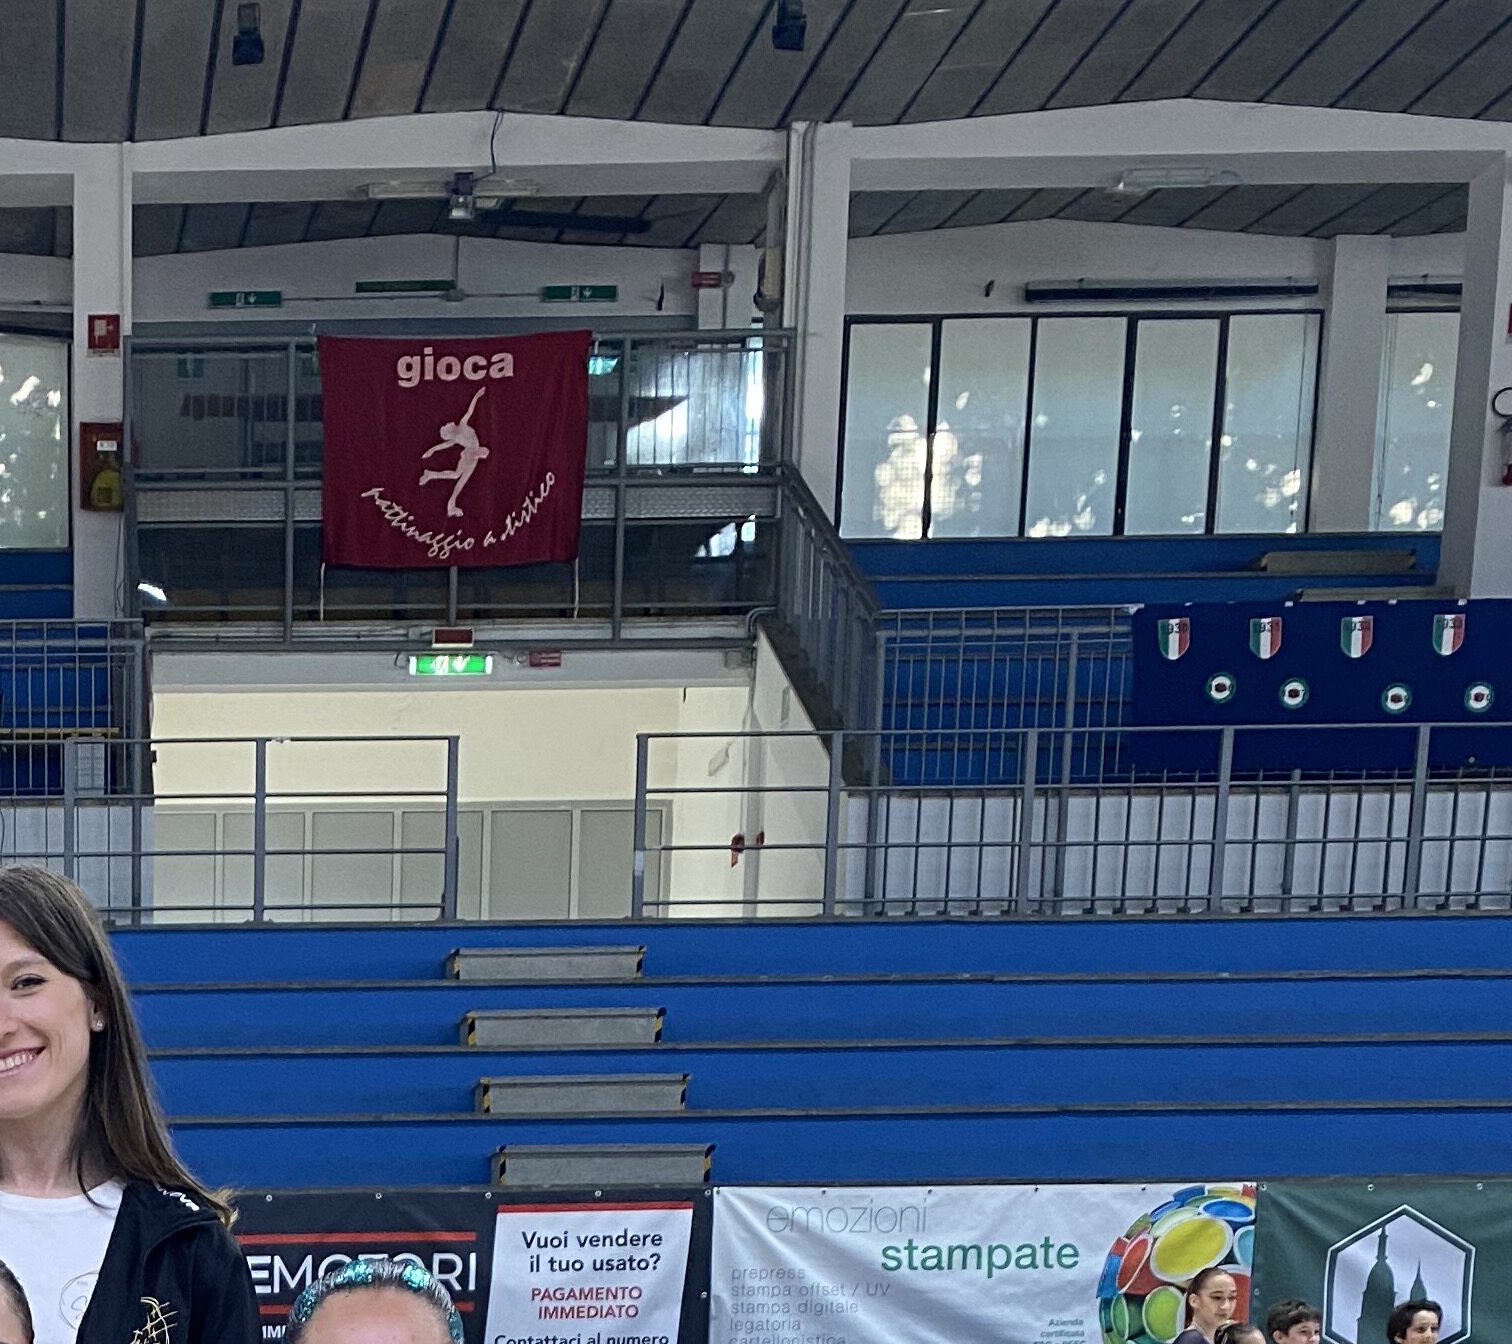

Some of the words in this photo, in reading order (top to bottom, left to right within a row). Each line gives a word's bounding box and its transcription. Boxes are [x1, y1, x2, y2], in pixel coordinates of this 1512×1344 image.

[396, 346, 514, 388] gioca
[766, 1197, 928, 1234] emozioni
[521, 1230, 569, 1249] Vuoi
[576, 1227, 664, 1248] vendere
[529, 1254, 541, 1273] il
[547, 1257, 584, 1273] tuo
[592, 1252, 662, 1272] usato?
[880, 1235, 1081, 1279] stampate
[246, 1251, 477, 1295] EMORI
[731, 1266, 806, 1281] prepress
[531, 1285, 644, 1302] PAGAMENTO
[731, 1284, 792, 1299] stampa
[799, 1282, 846, 1298] offset
[865, 1282, 891, 1297] UV
[538, 1304, 640, 1320] IMMEDIATO
[730, 1301, 791, 1317] stampa
[797, 1299, 859, 1317] digitale
[729, 1317, 802, 1335] legatoria
